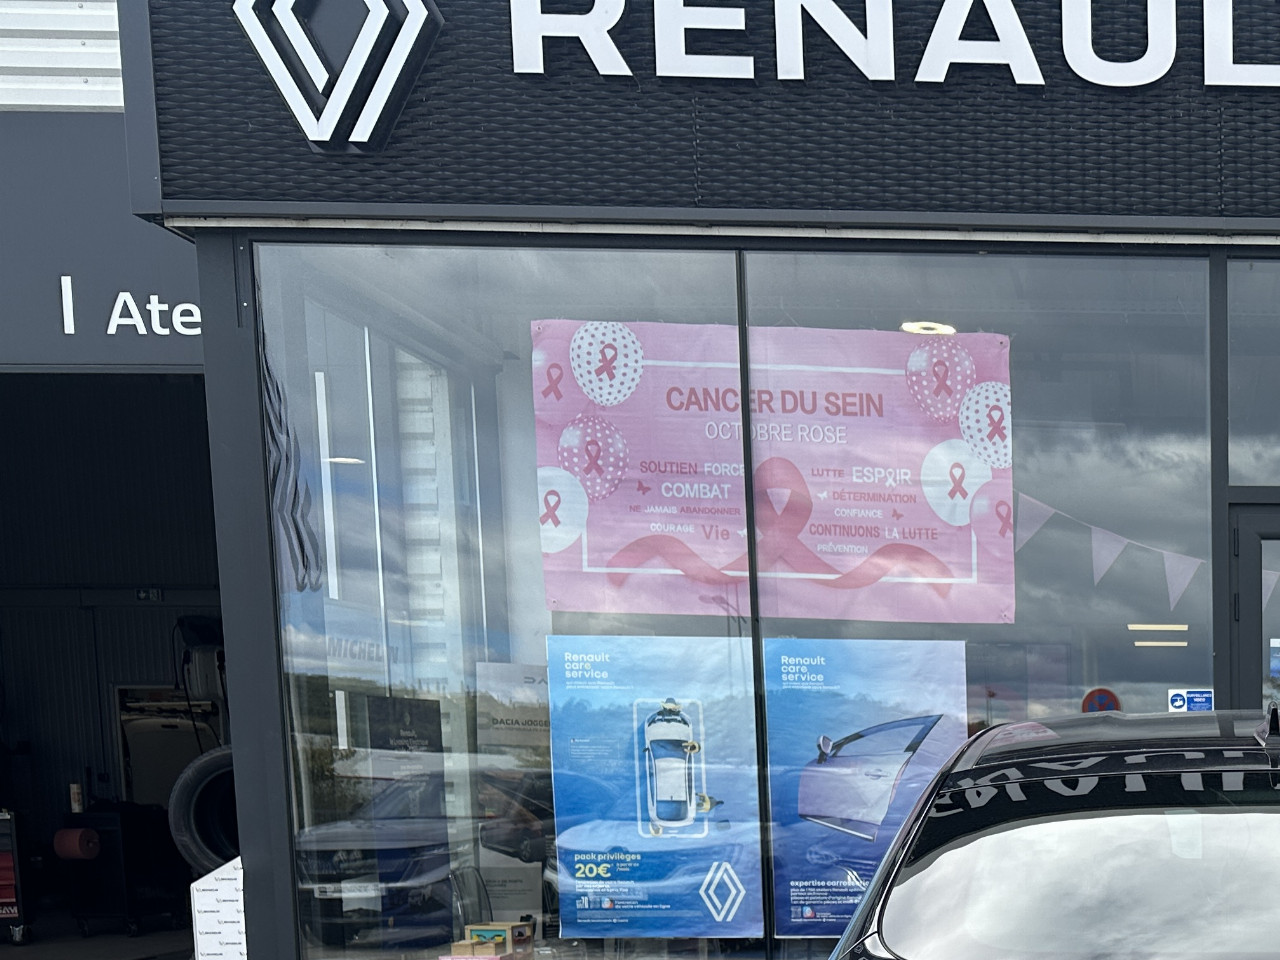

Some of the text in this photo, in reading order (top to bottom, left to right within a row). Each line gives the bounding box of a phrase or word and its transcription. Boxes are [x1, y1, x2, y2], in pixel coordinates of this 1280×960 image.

[780, 390, 817, 415] DU
[824, 392, 884, 417] SEIN
[797, 424, 848, 443] ROSE
[640, 461, 698, 475] SOUTIEN
[811, 467, 845, 478] LUTTE
[661, 482, 731, 499] COMBAT
[832, 488, 917, 503] DÉTERMINATION
[629, 505, 741, 515] NE JAMAIS ABANDONNER
[834, 508, 883, 518] CONFIANCE
[650, 523, 730, 540] COURAGE Vie
[809, 523, 938, 540] CONTINUONS LA LUTTE
[564, 652, 610, 662] Renault
[781, 656, 826, 665] Renault
[565, 662, 591, 670] care
[781, 665, 808, 673] care
[565, 669, 608, 679] service
[782, 672, 824, 681] service
[492, 718, 520, 726] DACIA
[574, 853, 641, 861] pack privilèges
